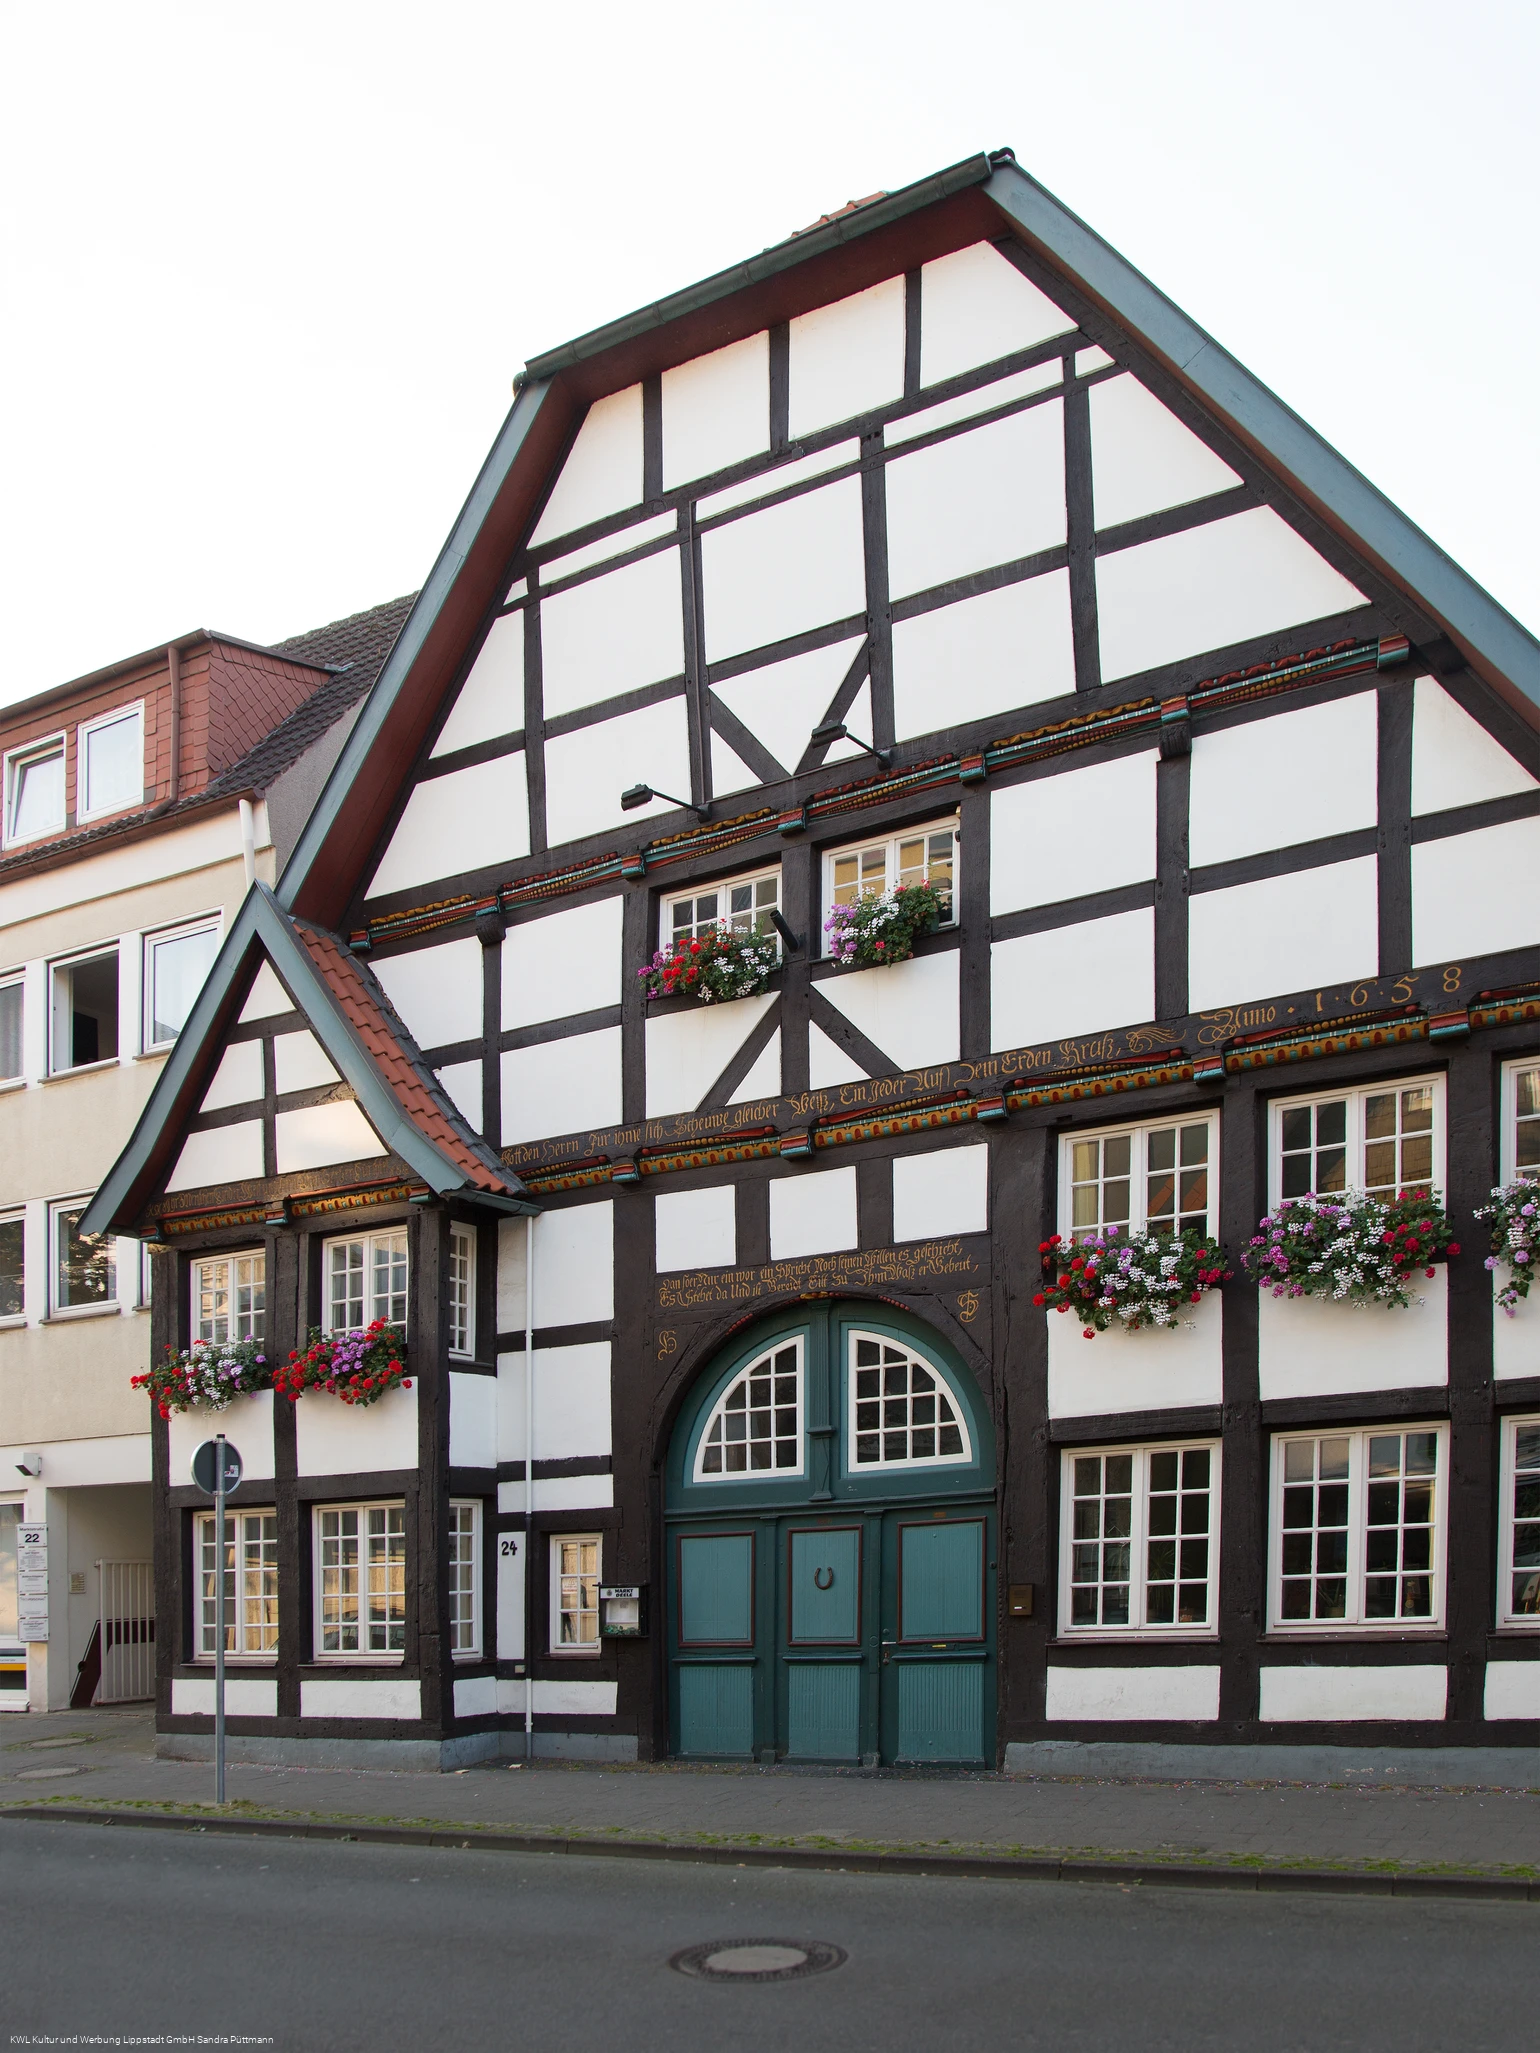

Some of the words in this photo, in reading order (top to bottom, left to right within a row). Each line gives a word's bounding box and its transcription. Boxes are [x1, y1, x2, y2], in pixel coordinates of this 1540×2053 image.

[522, 1146, 539, 1162] den
[541, 1140, 579, 1162] Herrn
[839, 1084, 866, 1105] Ein
[1001, 1048, 1052, 1075] Erden
[1197, 1005, 1276, 1045] Anno
[24, 1533, 40, 1543] 22
[501, 1540, 518, 1556] 24
